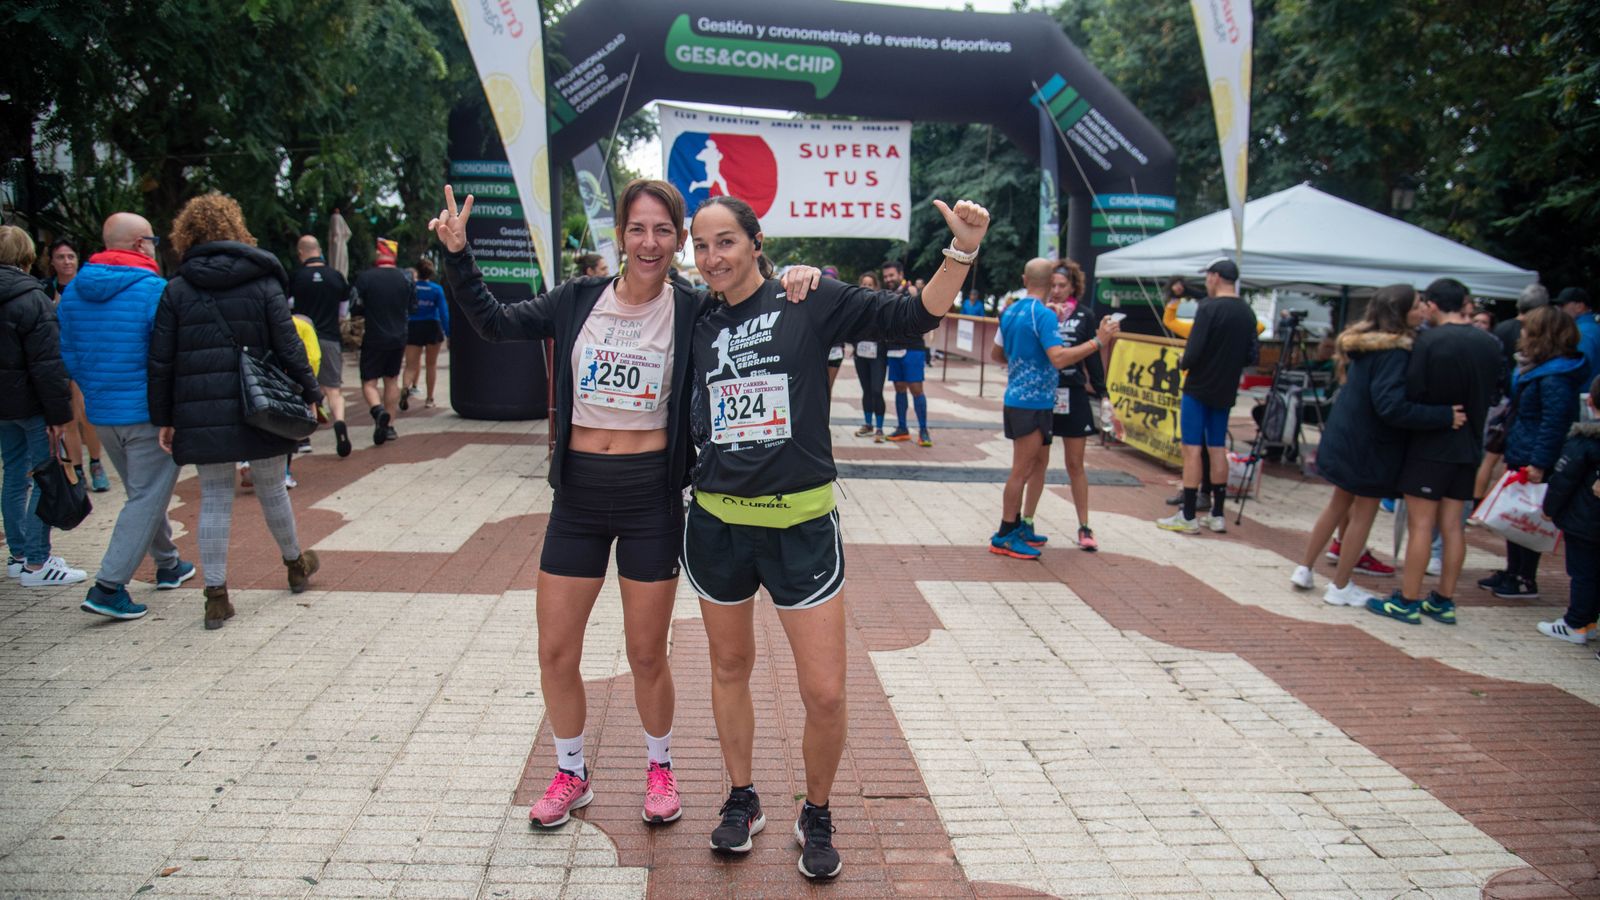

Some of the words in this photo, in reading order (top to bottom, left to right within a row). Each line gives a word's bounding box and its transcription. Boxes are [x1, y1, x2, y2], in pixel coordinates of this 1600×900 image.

[698, 16, 753, 35] Gestión
[756, 25, 766, 39] y
[768, 25, 861, 47] cronometraje
[863, 31, 882, 46] de
[884, 35, 938, 50] eventos
[940, 37, 1012, 53] deportivos
[676, 45, 835, 74] GES&CON-CHIP
[799, 143, 901, 158] SUPERA
[825, 170, 879, 187] TUS
[464, 184, 510, 195] EVENTOS
[790, 201, 902, 219] LIMITES
[500, 226, 530, 236] Gestió
[480, 266, 539, 278] CON-CHIP
[620, 319, 643, 328] CAN
[733, 311, 781, 339] XIV
[618, 330, 641, 339] RUN
[615, 338, 639, 348] THIS
[729, 335, 772, 352] ESTRECHO
[594, 349, 620, 362] XIV
[620, 353, 647, 361] CARRERA
[736, 353, 758, 364] PEPE
[737, 355, 780, 370] SERRANO
[597, 362, 640, 390] 250
[720, 383, 742, 398] XIV
[726, 393, 767, 421] 324
[740, 500, 791, 509] LURBEL
